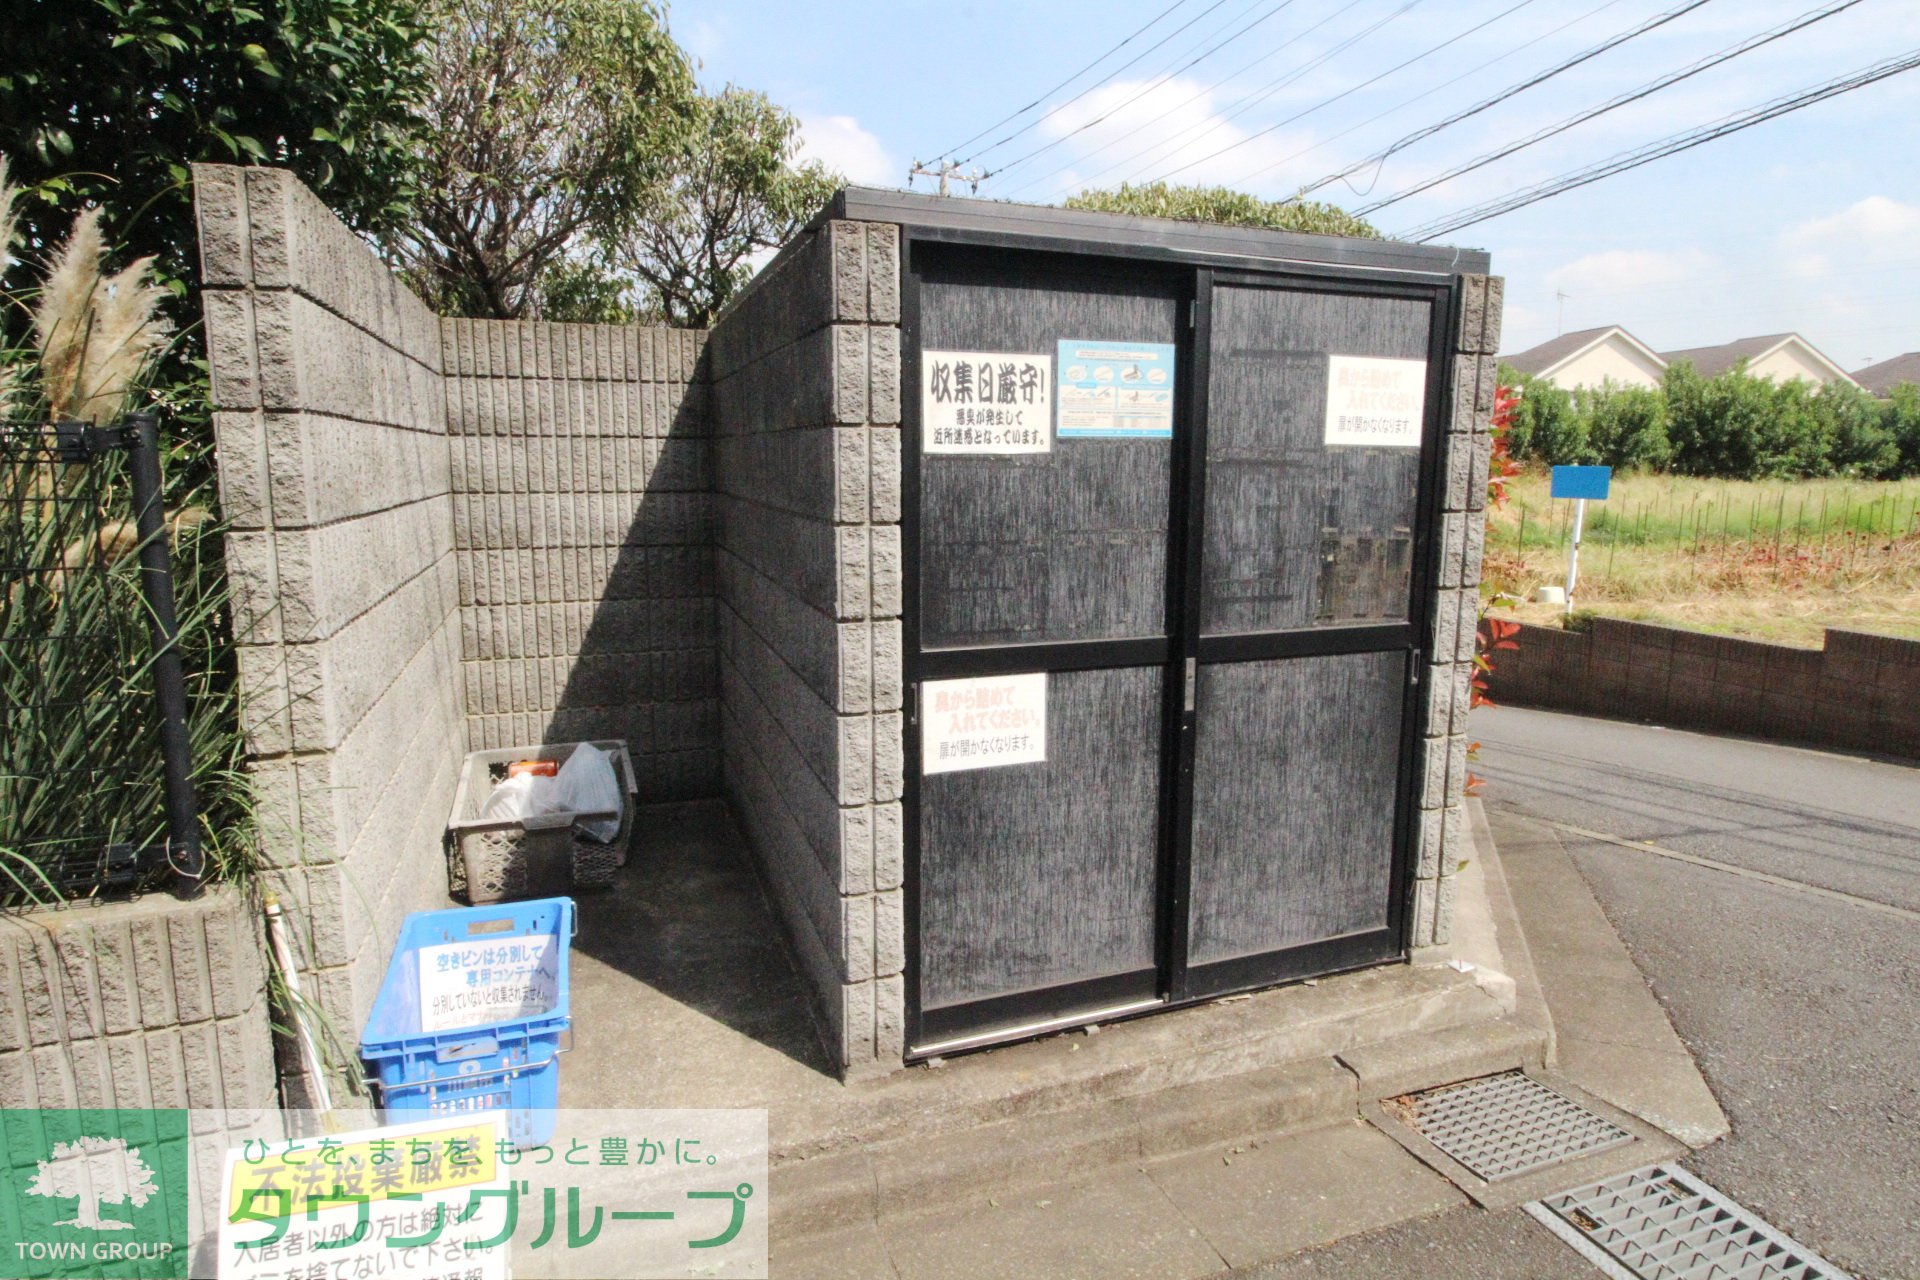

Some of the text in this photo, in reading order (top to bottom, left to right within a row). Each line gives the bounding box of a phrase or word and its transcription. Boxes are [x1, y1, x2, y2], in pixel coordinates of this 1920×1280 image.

[930, 360, 1045, 405] 収集日厳守!
[956, 408, 1024, 426] 悪臭が発生して
[933, 427, 1045, 446] 近所迷惑となっています。
[948, 707, 1041, 735] 入れてください。
[939, 735, 1034, 759] 扉が開かなくなります。
[248, 1133, 481, 1212] 不法投棄厳禁
[233, 1200, 484, 1268] 入居者以外の方は絶対に
[242, 1232, 494, 1280] を捨てないで下さい。
